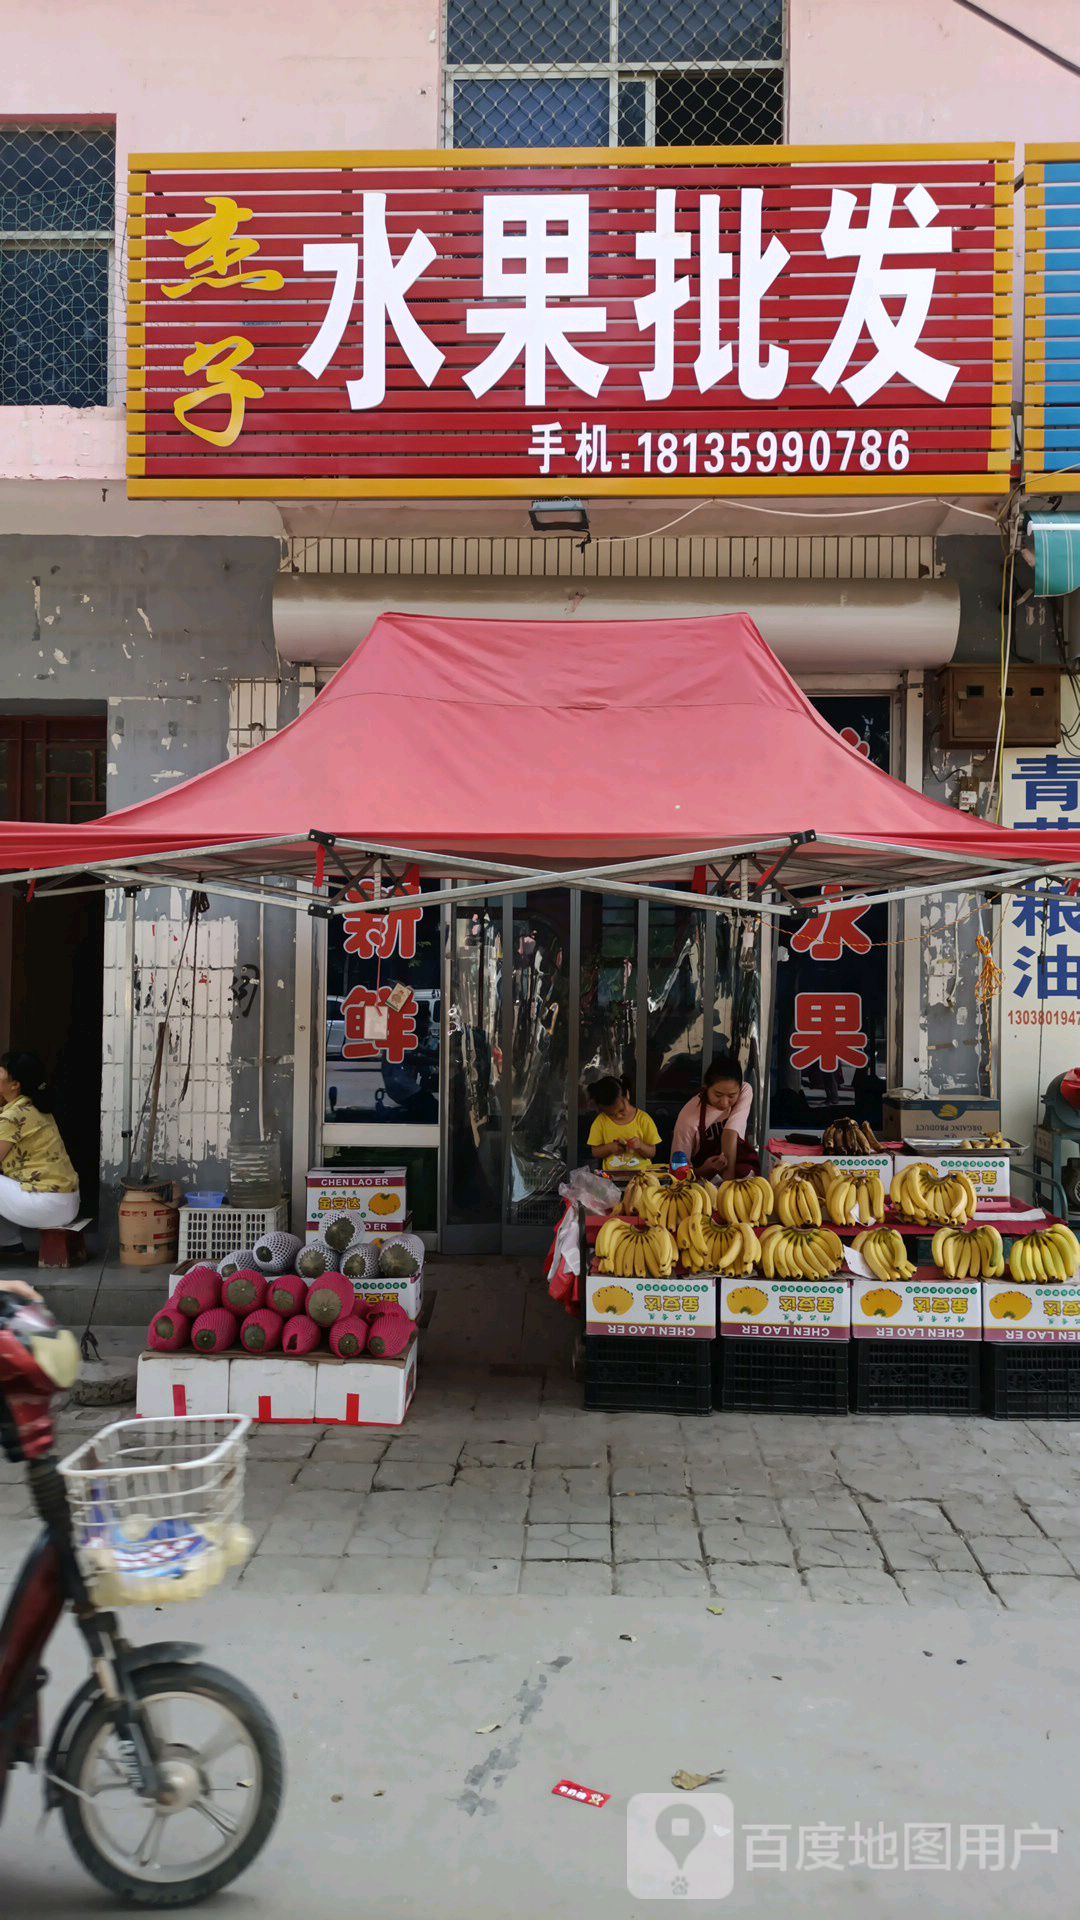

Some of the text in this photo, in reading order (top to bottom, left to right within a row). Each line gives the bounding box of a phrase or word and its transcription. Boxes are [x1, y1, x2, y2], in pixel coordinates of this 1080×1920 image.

[299, 183, 960, 410] 水果批发
[161, 196, 285, 447] 杰子
[342, 878, 424, 1064] 新鲜
[790, 884, 872, 1073] 水果
[916, 1124, 948, 1132] PRODUCT
[321, 1178, 389, 1187] CHEN LAO ER
[607, 1324, 696, 1337] CHEN LAO ER
[742, 1325, 830, 1337] CHEN LAO ER
[876, 1327, 965, 1338] CHEN LAO ER
[1005, 1330, 1024, 1340] ER
[1027, 1330, 1054, 1340] LAO
